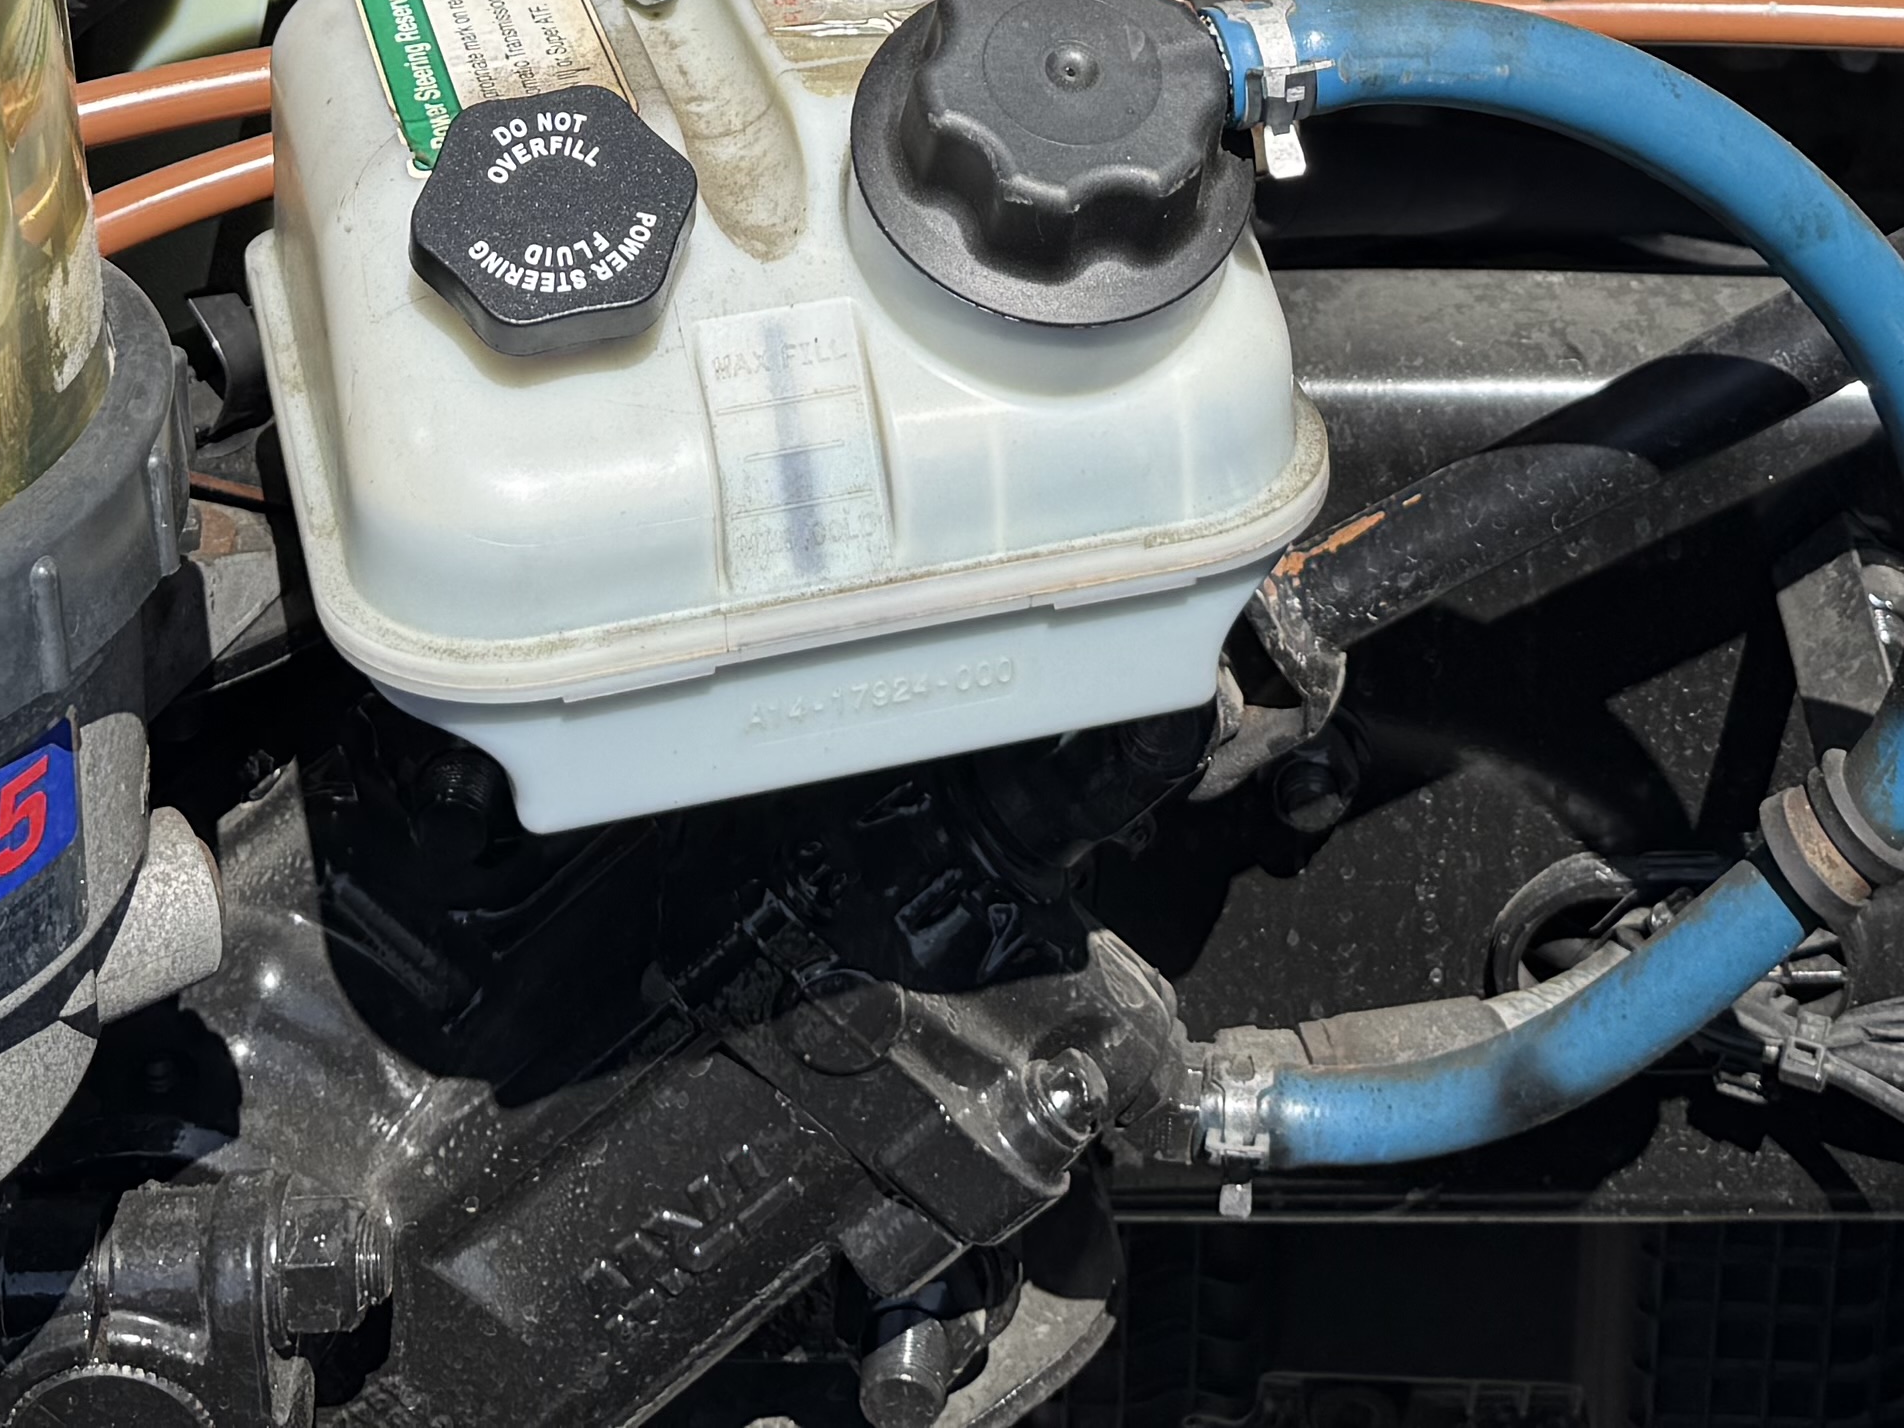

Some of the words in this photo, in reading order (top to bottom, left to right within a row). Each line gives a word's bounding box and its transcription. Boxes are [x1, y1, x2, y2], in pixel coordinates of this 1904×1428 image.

[453, 9, 469, 24] on
[458, 24, 482, 52] mark
[542, 25, 569, 55] Super
[403, 41, 441, 101] Steering
[491, 117, 529, 146] DO
[537, 112, 588, 133] NOT
[487, 136, 601, 184] OVERFILL
[468, 240, 587, 293] STEERING
[524, 232, 610, 266] FLUID
[595, 212, 657, 282] POWER
[714, 348, 765, 382] MAX
[781, 336, 848, 376] FILL
